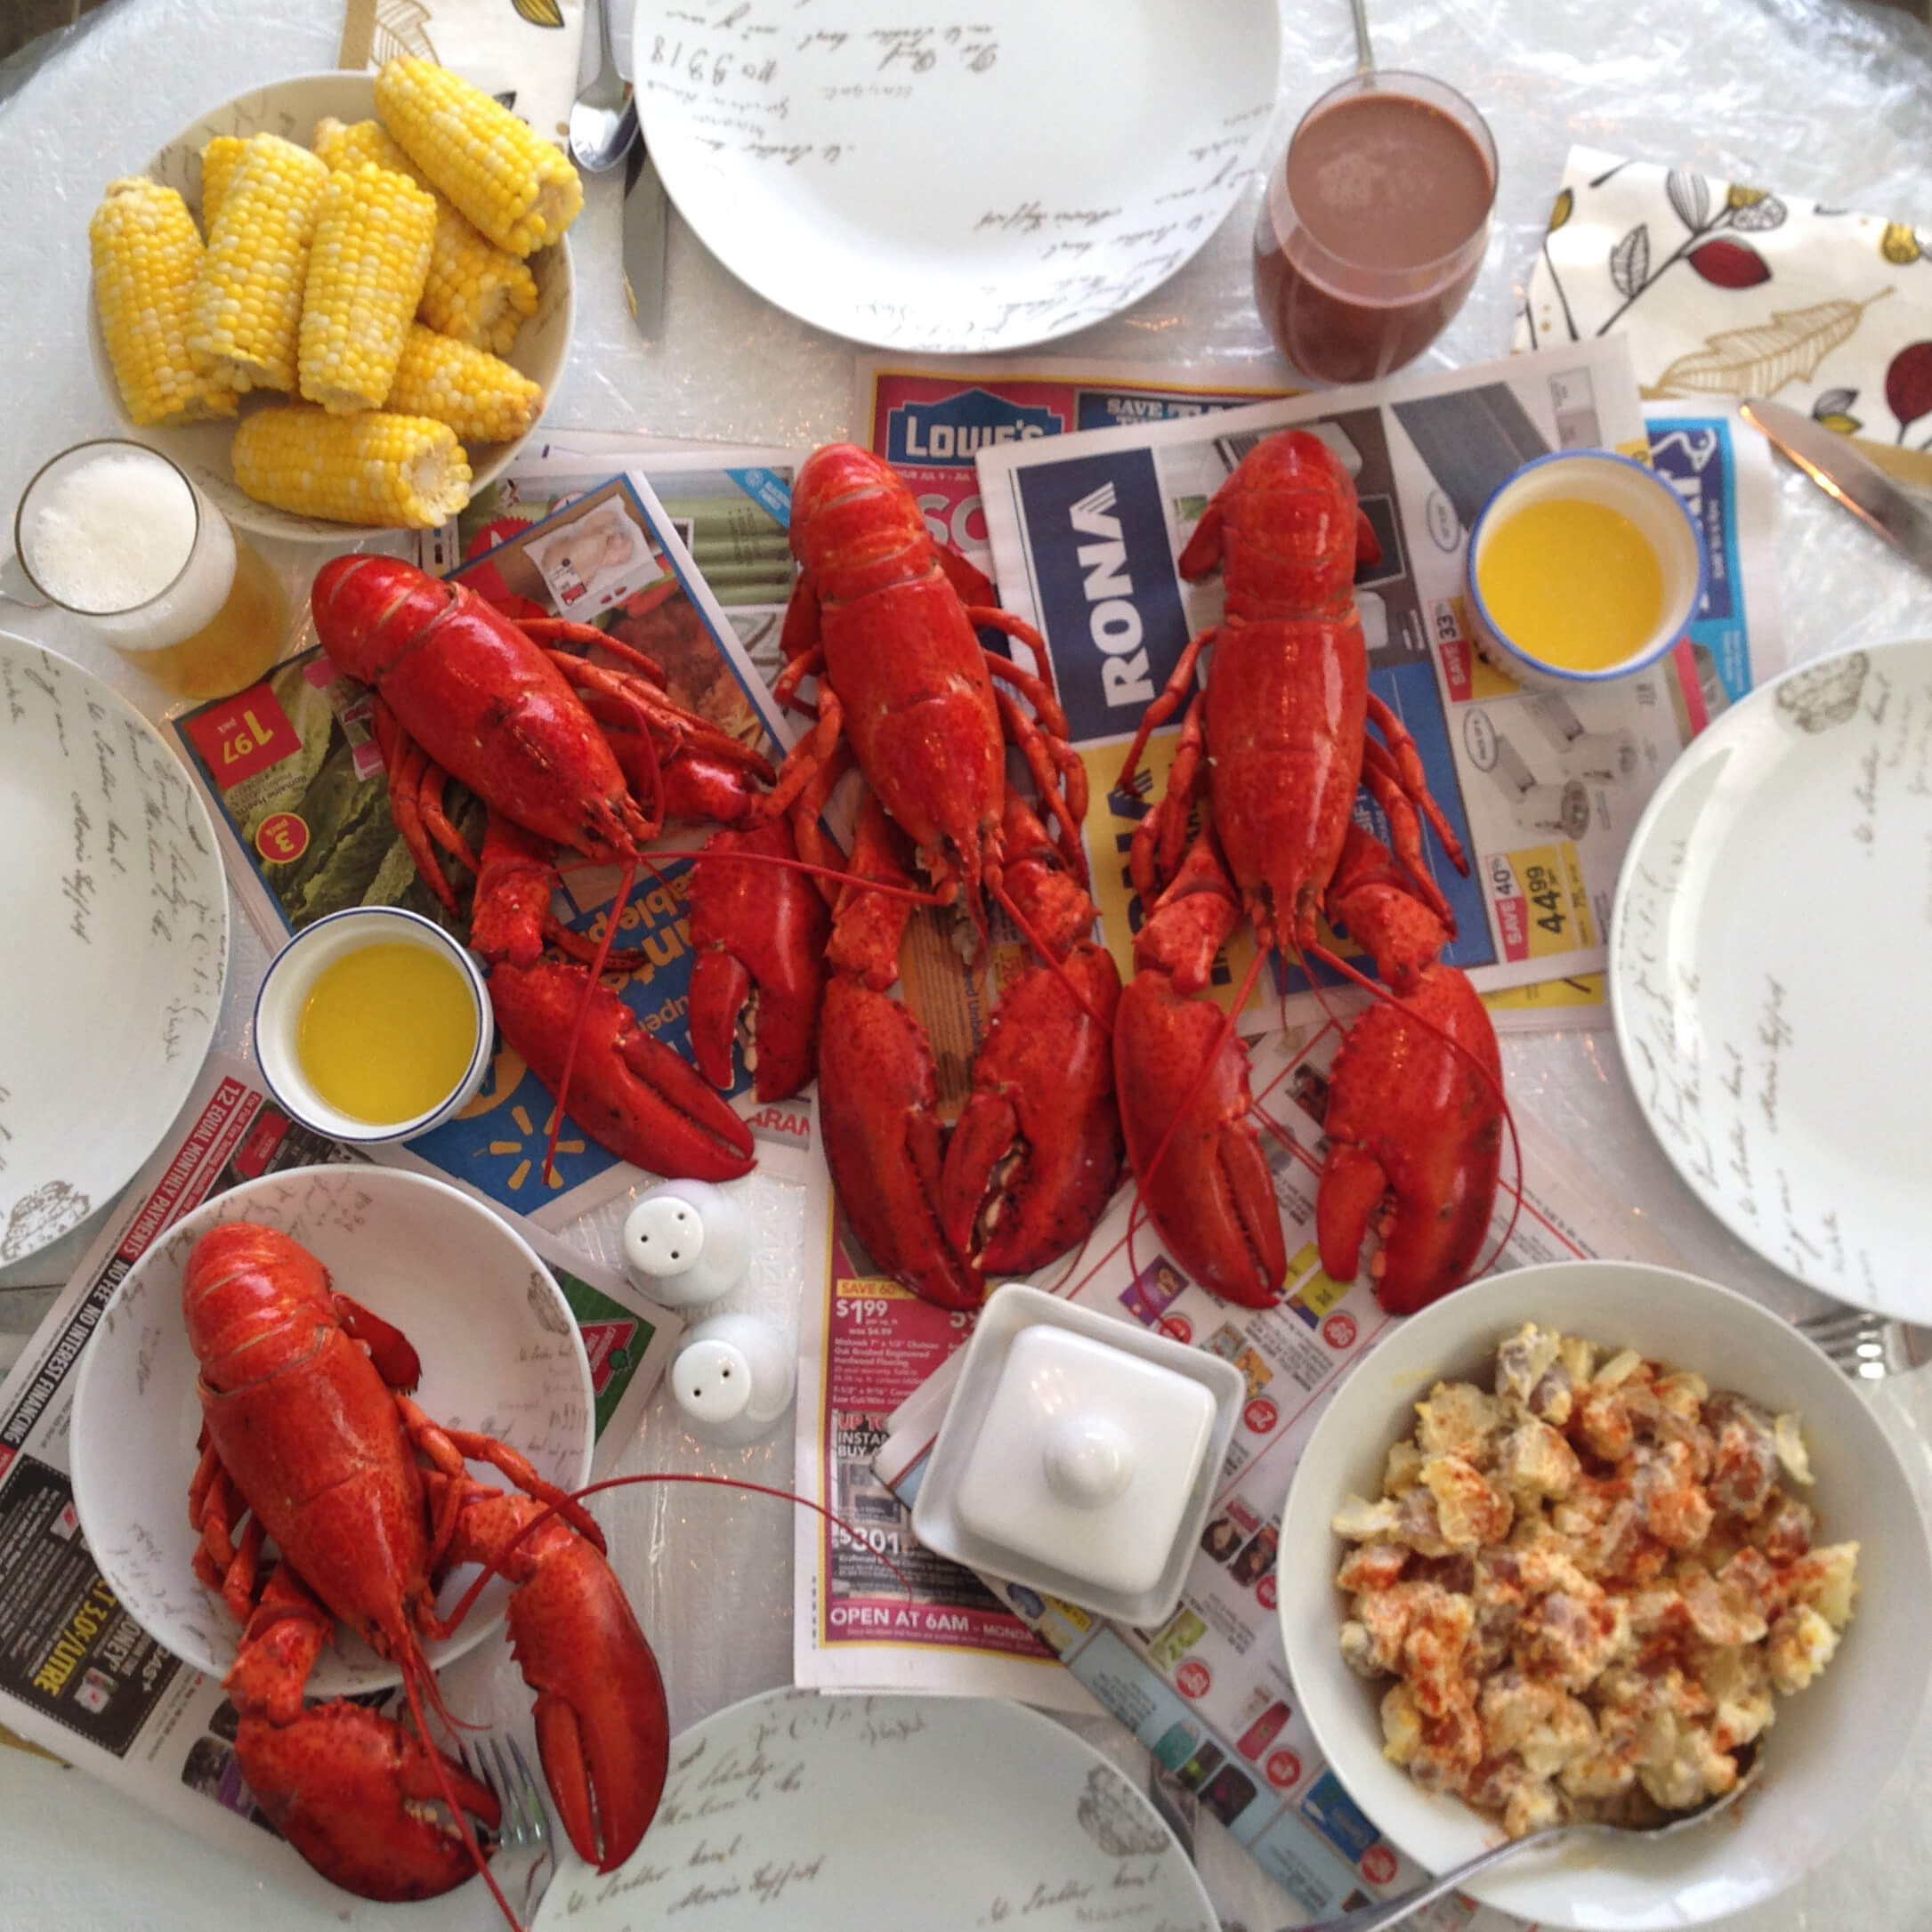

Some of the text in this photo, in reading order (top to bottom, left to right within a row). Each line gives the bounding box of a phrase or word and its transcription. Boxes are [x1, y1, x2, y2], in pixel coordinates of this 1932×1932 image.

[1107, 398, 1162, 417] SAVE
[1069, 481, 1155, 707] RONA
[1444, 644, 1466, 686] SAVE
[271, 829, 296, 854] 3
[1499, 898, 1524, 945] SAVE
[121, 1081, 239, 1257] 12 EQUAL MONTHLY PAYMENTS
[104, 1257, 129, 1283] NO
[842, 1283, 875, 1291] SAVE
[76, 1301, 101, 1329] NO
[42, 1322, 88, 1383] INTEREST
[3, 1376, 54, 1445] FINANCING
[838, 1414, 862, 1430] UP
[837, 1445, 867, 1458] BUY
[829, 1607, 890, 1627] OPEN
[895, 1611, 920, 1628] AT
[926, 1613, 969, 1632] 6AM
